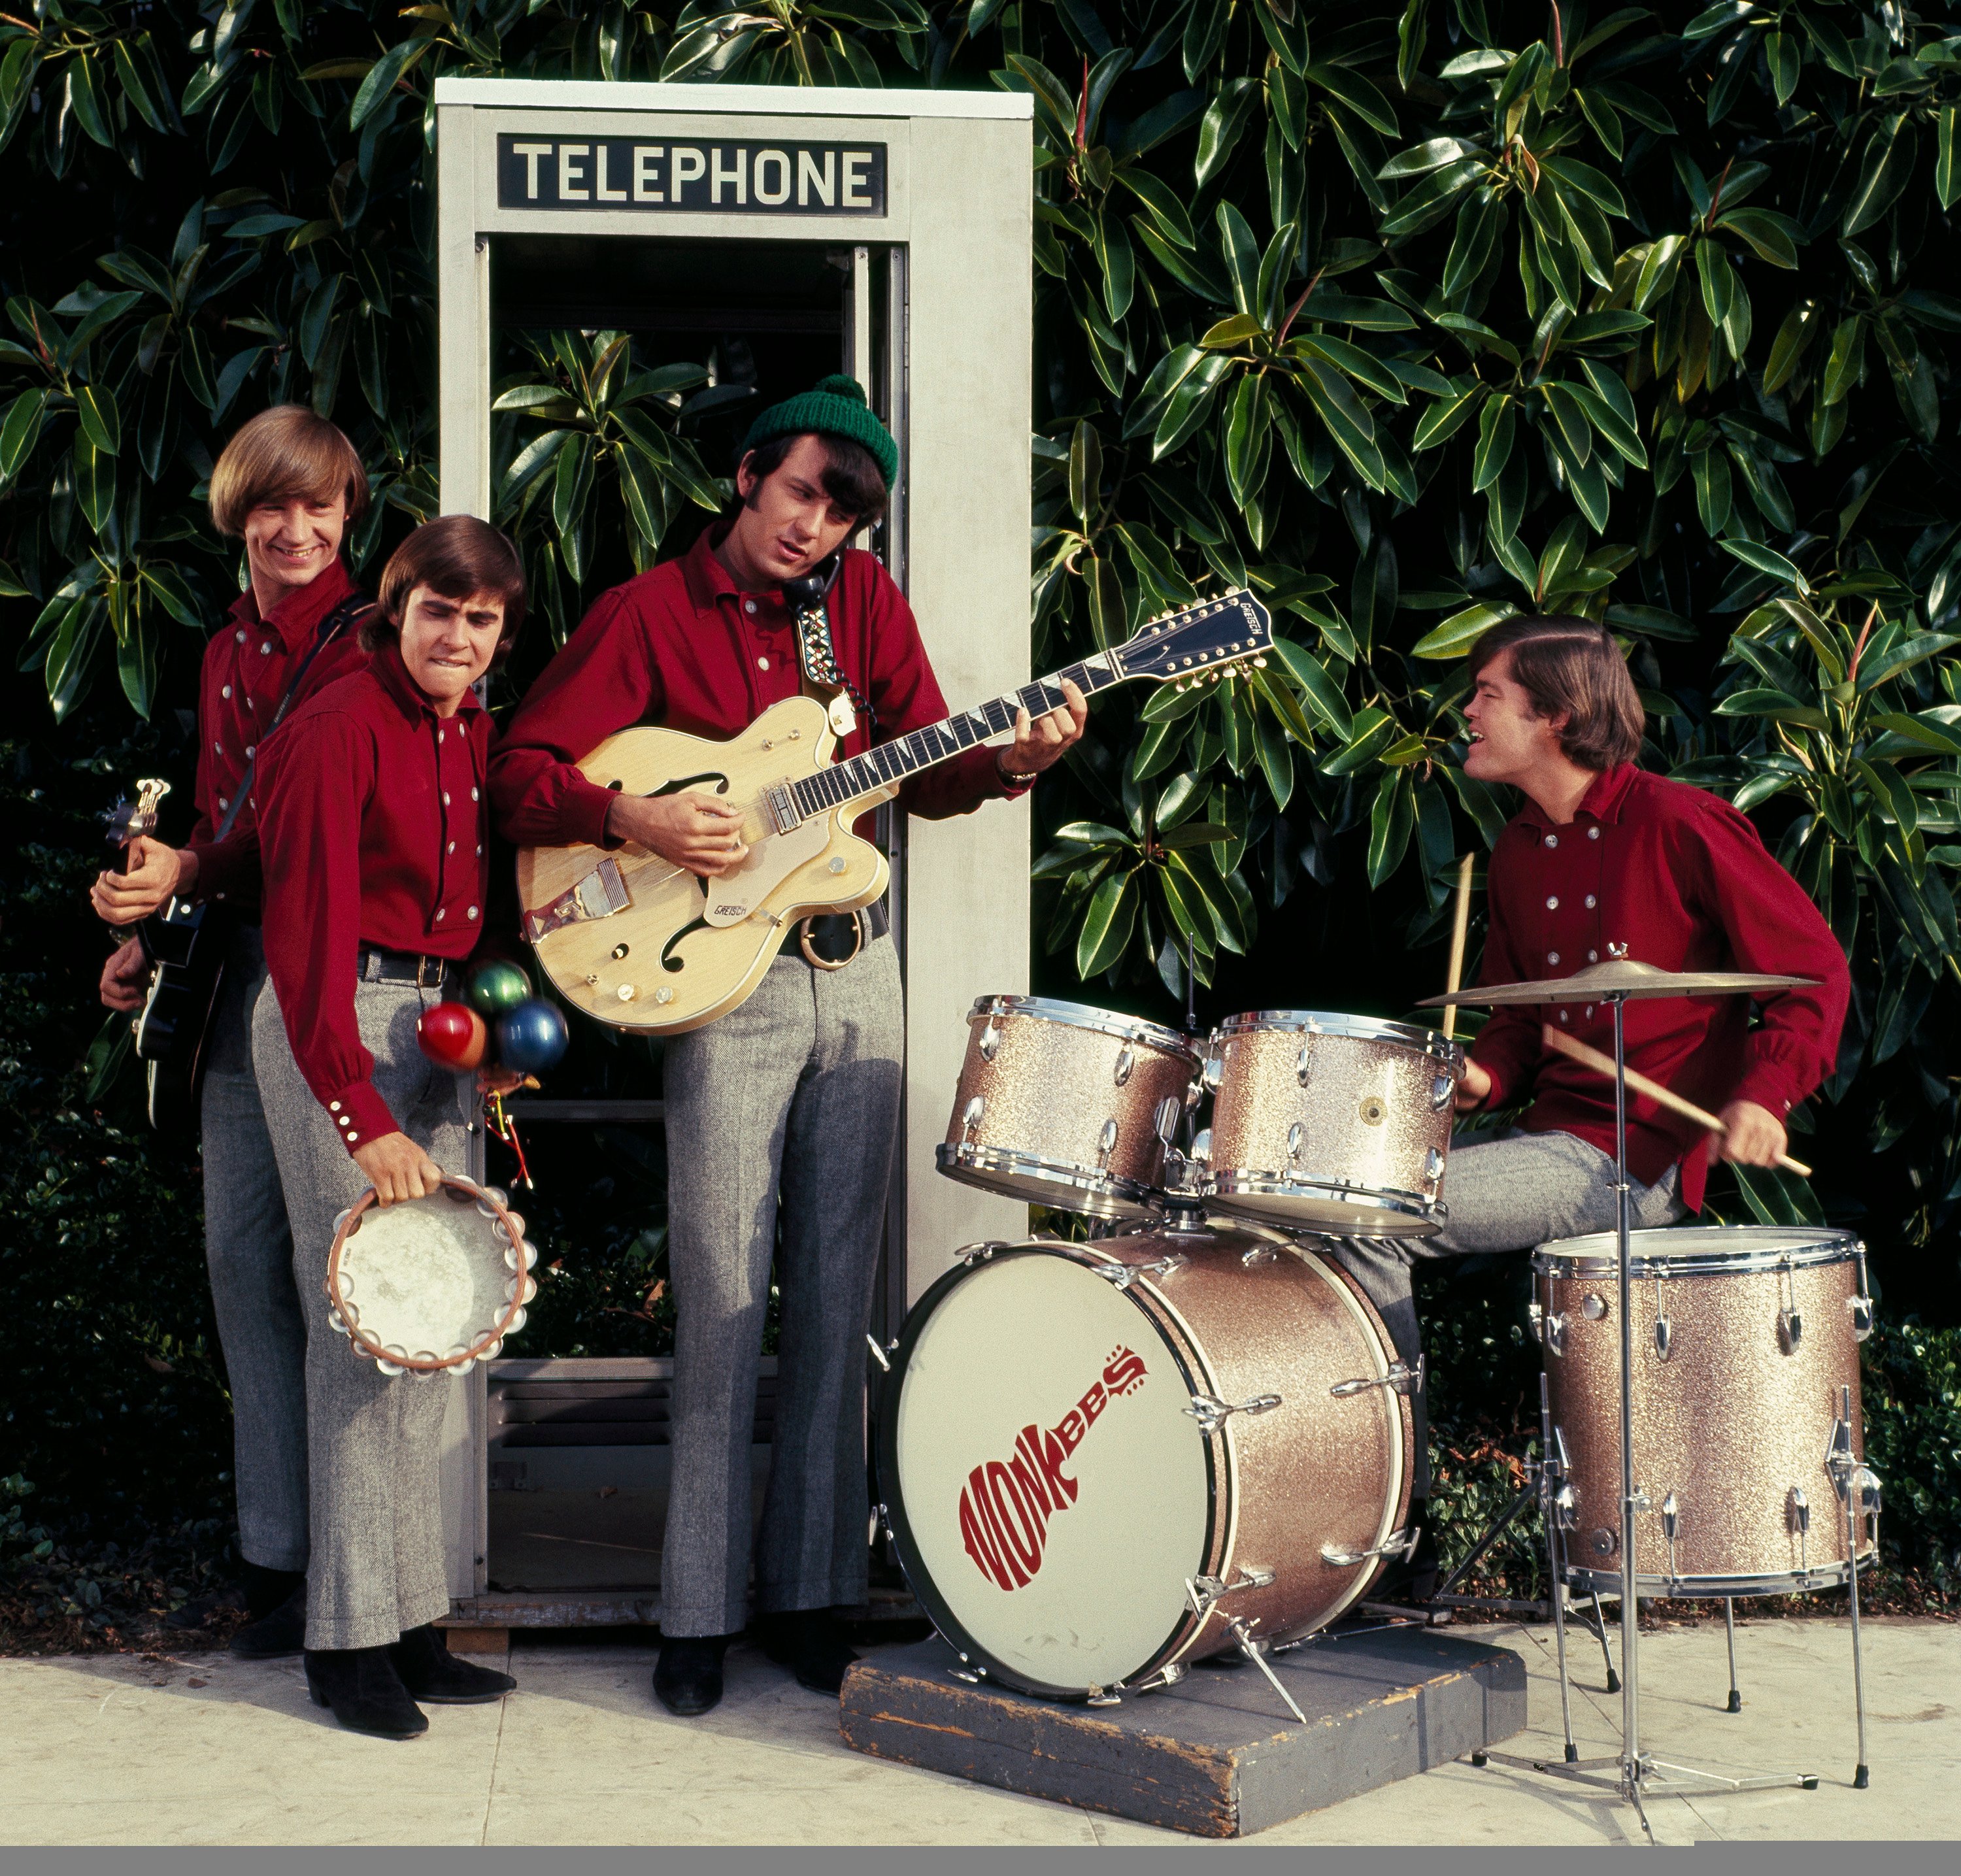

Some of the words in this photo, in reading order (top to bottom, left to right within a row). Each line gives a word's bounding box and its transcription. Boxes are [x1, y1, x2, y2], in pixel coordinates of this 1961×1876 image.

[513, 143, 872, 208] TELEPHONE
[1240, 603, 1264, 635] GRETSCH
[714, 905, 747, 916] GRETSCH
